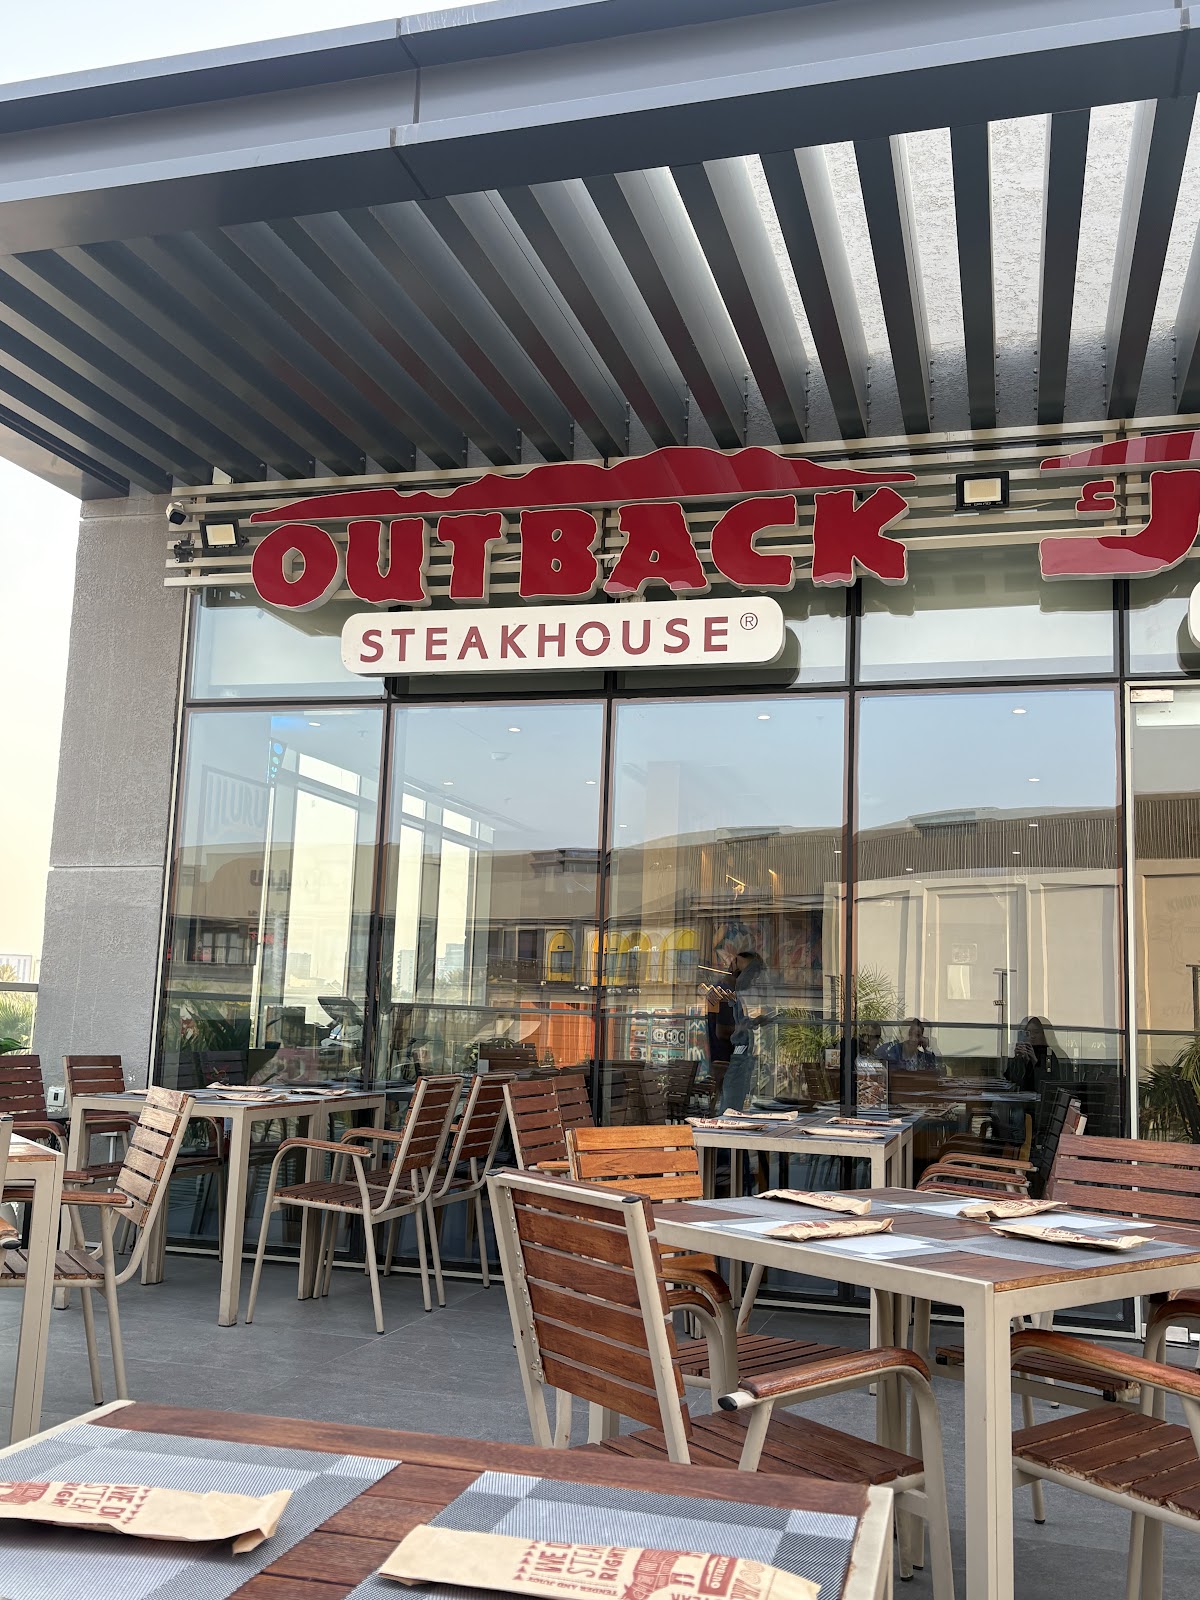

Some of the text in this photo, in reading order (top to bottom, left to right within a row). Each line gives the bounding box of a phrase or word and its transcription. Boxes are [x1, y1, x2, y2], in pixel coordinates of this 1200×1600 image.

[251, 487, 909, 608] OUTBACK
[534, 1551, 568, 1574] WE
[526, 1577, 618, 1597] TENDER AND JUICY
